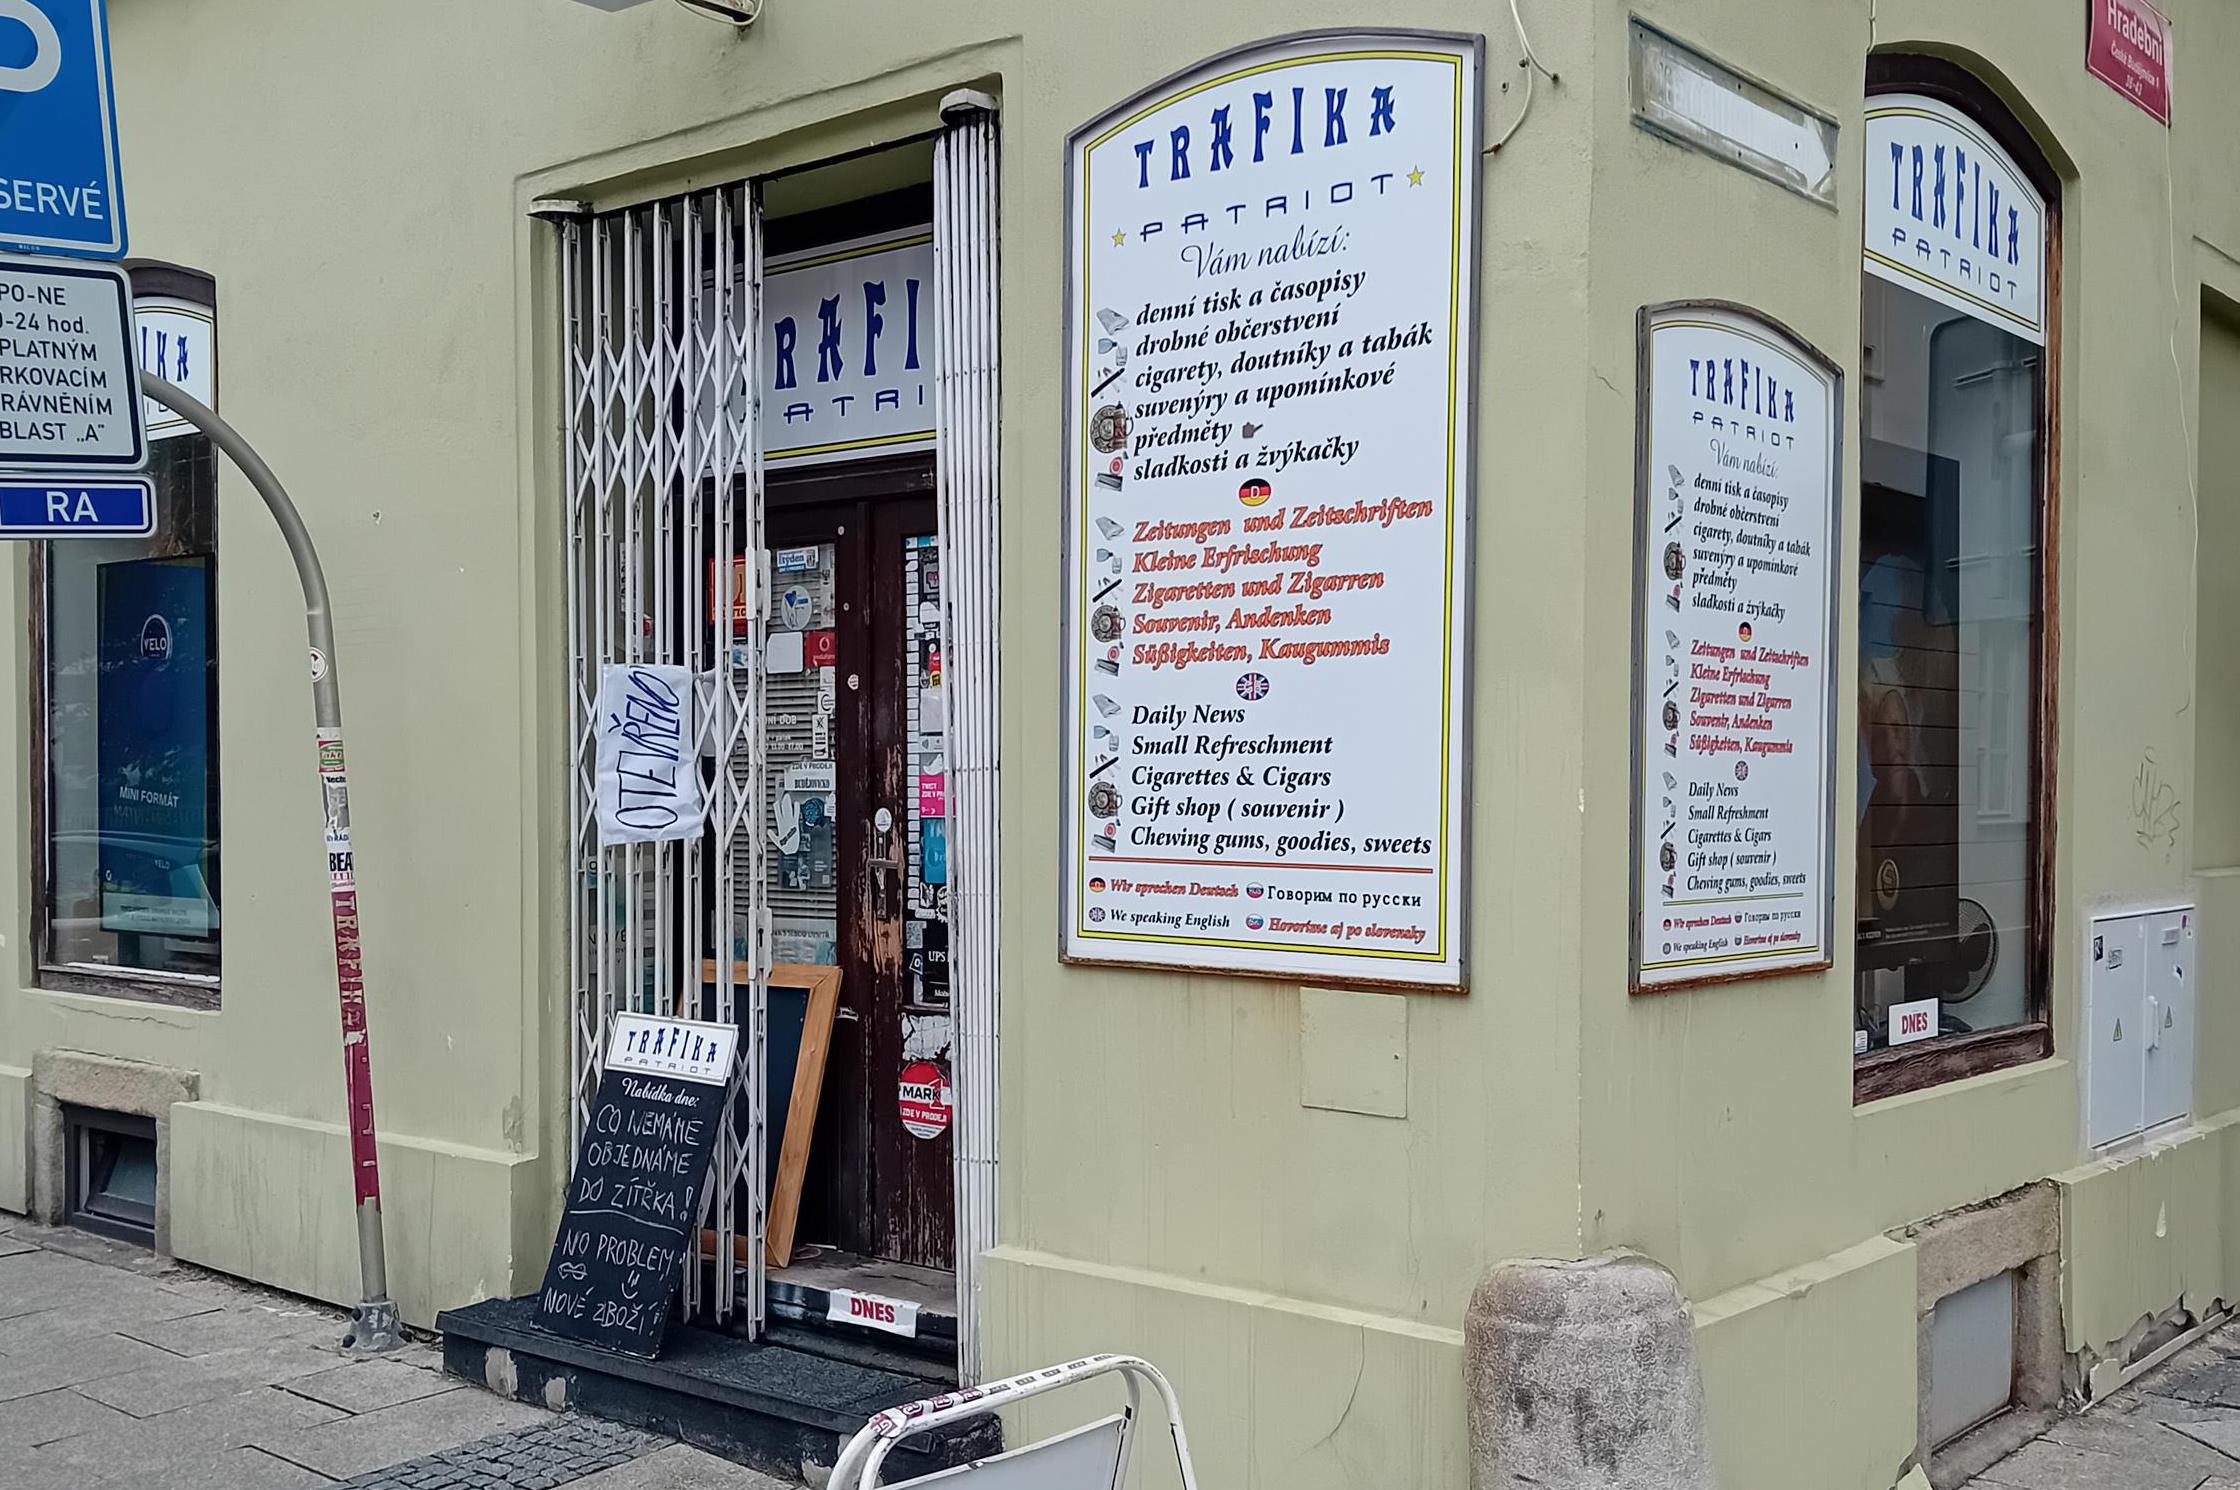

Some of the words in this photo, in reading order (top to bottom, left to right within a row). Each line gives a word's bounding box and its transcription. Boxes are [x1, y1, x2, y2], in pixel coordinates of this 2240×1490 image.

[1134, 85, 1396, 189] TRAFIKA
[1140, 173, 1394, 243] PATRIOT
[1890, 140, 2020, 266] TRAFIKA
[1180, 241, 1253, 278] Vám
[1257, 224, 1350, 267] nabízí:
[1892, 226, 2018, 301] PATRIOT
[1136, 296, 1196, 326] denní
[1203, 290, 1242, 315] tisk
[1250, 290, 1263, 307] a
[1270, 269, 1366, 304] časopisy
[48, 314, 89, 334] hod.
[1136, 325, 1209, 357] drobné
[1215, 302, 1341, 346] občerstvení
[1135, 361, 1223, 393] cigarety,
[1230, 340, 1331, 376] doutníky
[1339, 340, 1352, 357] a
[1362, 321, 1433, 354] tabák
[1135, 391, 1228, 421] suvenýry
[1235, 388, 1248, 406] a
[1256, 361, 1396, 408] upomínkové
[1690, 358, 1795, 423] TRAFIKA
[1134, 420, 1233, 457] předměty
[1693, 411, 1795, 450] PATRIOT
[1134, 450, 1228, 481] sladkosti
[1235, 451, 1249, 469] a
[1256, 435, 1360, 467] žvýkačky
[1710, 438, 1741, 469] Vám
[1694, 473, 1722, 488] denní
[1724, 480, 1742, 498] tisk
[1752, 487, 1789, 512] časopisy
[47, 491, 98, 523] RA
[1132, 518, 1231, 545] Zeitungen
[1243, 508, 1287, 533] und
[1289, 497, 1433, 529] Zeitschriften
[1694, 497, 1728, 518] drobné
[1693, 522, 1734, 544] cigarety,
[1736, 530, 1777, 554] doutníky
[1786, 540, 1811, 557] tabák
[1132, 549, 1197, 573] Kleine
[1201, 541, 1323, 574] Erfrischung
[1693, 547, 1735, 570] suvenýry
[1132, 579, 1235, 609] Zigaretten
[1241, 572, 1283, 599] und
[1287, 570, 1384, 599] Zigarren
[1692, 568, 1737, 592] předměty
[1692, 592, 1735, 613] sladkosti
[1132, 611, 1221, 635] Souvenir,
[1226, 604, 1332, 630] Andenken
[142, 637, 167, 652] VELO
[1132, 640, 1253, 671] Süßigkeiten,
[1259, 632, 1391, 666] Kaugummis
[1740, 646, 1757, 661] und
[1690, 664, 1720, 681] Kleine
[1738, 692, 1755, 706] und
[1132, 705, 1187, 731] Daily
[1192, 705, 1245, 724] News
[1132, 735, 1189, 755] Small
[1194, 735, 1334, 761] Refreschment
[1132, 766, 1230, 792] Cigarettes
[1236, 766, 1255, 787] &
[1262, 766, 1331, 793] Cigars
[1689, 782, 1714, 802] Daily
[1716, 783, 1739, 797] News
[119, 785, 139, 802] MINI
[140, 787, 179, 809] FORMÁT
[1131, 796, 1171, 822] Gift
[1176, 796, 1221, 822] shop
[1241, 799, 1331, 819] souvenir
[1688, 805, 1714, 820] Small
[1131, 826, 1210, 854] Chewing
[1214, 833, 1270, 855] gums,
[1276, 830, 1356, 856] goodies,
[1363, 836, 1432, 855] sweets
[1688, 828, 1731, 848] Cigarettes
[1734, 828, 1742, 842] &
[1745, 828, 1771, 846] Cigars
[1688, 852, 1706, 871] Gift
[1709, 852, 1728, 869] shop
[1736, 851, 1771, 865] souvenir
[1110, 878, 1133, 892] Wir
[1134, 882, 1187, 897] sprechen
[1268, 886, 1333, 904] Говорим
[1339, 892, 1357, 904] по
[1362, 895, 1422, 909] русски
[1688, 875, 1723, 894] Chewing
[1110, 908, 1126, 922] We
[1127, 911, 1182, 930] speaking
[1185, 913, 1231, 930] English
[928, 951, 946, 962] UPS
[1901, 1011, 1929, 1036] DNES
[628, 1024, 717, 1064] TRAFIKA
[624, 1056, 711, 1075] PATRIOT
[622, 1077, 672, 1106] Nabídka
[596, 1103, 619, 1136] CO
[626, 1108, 703, 1147] NEMÁME
[587, 1139, 691, 1176] OBJEDNÁME
[579, 1176, 604, 1203] DO
[562, 1229, 590, 1257] NO
[543, 1287, 594, 1318] NOVÉ
[850, 1297, 896, 1323] DNES
